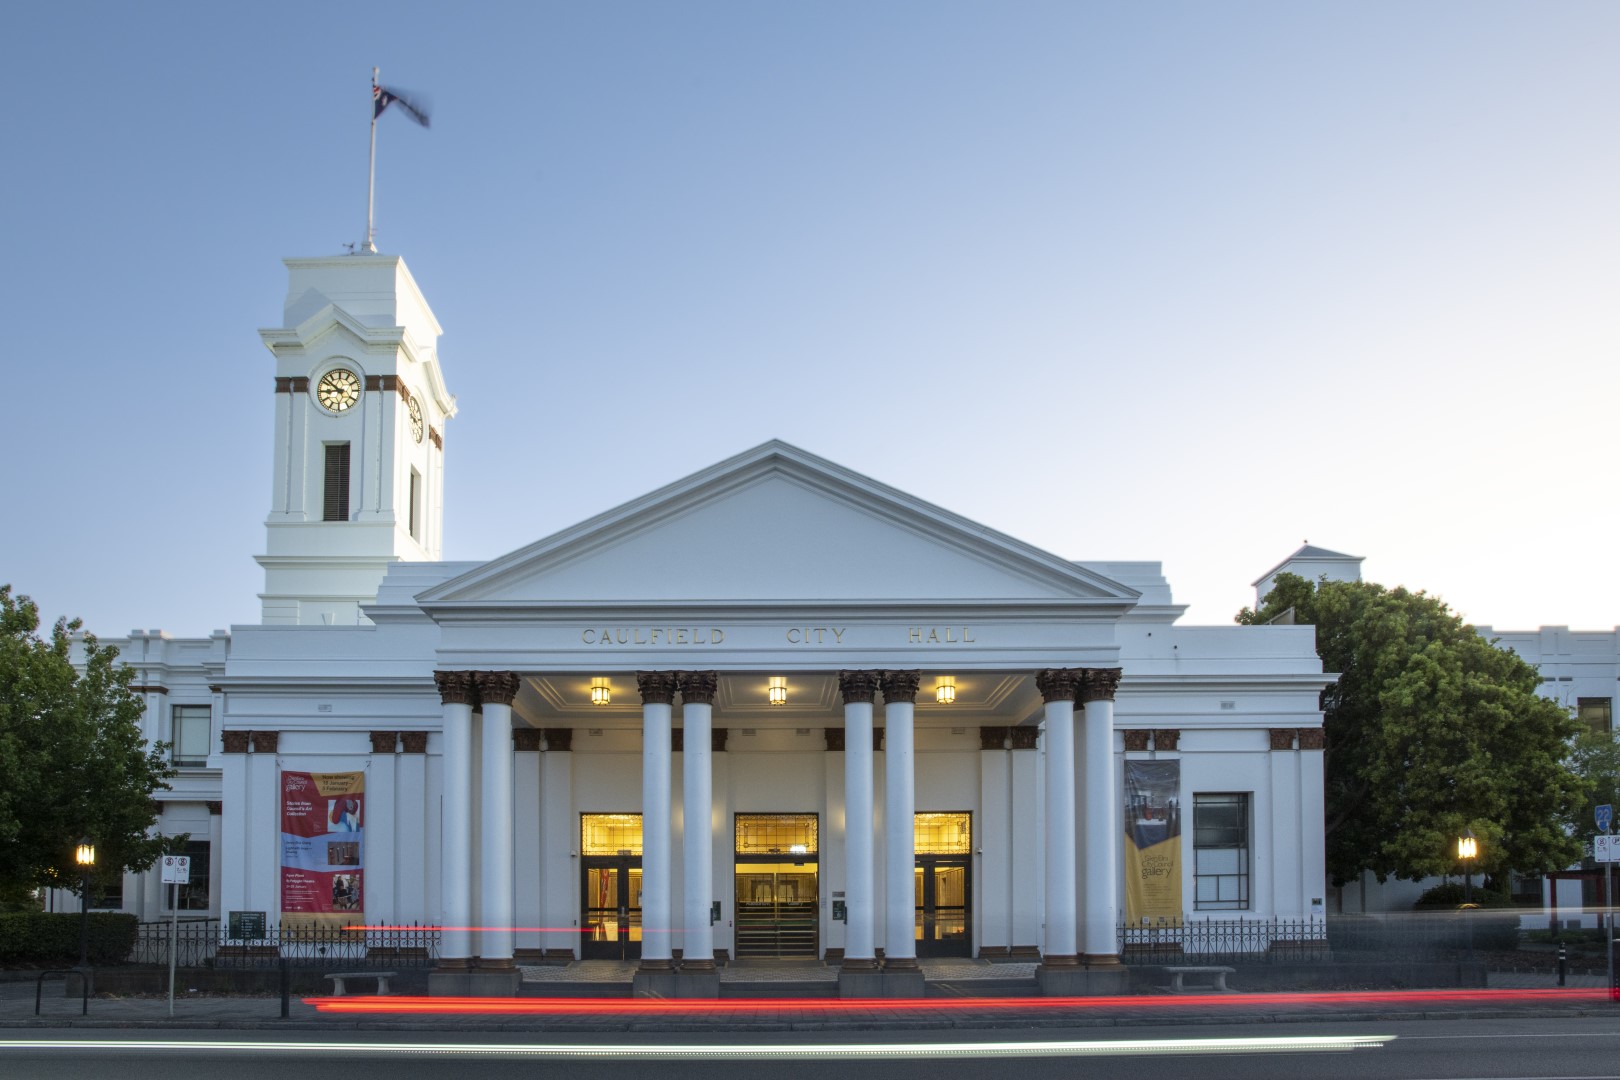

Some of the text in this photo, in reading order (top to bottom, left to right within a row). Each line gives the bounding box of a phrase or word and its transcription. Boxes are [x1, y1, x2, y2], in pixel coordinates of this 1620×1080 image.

[582, 627, 976, 645] CAULFIELD CITY HALL
[1597, 809, 1609, 822] 22
[1141, 867, 1172, 880] gallery
